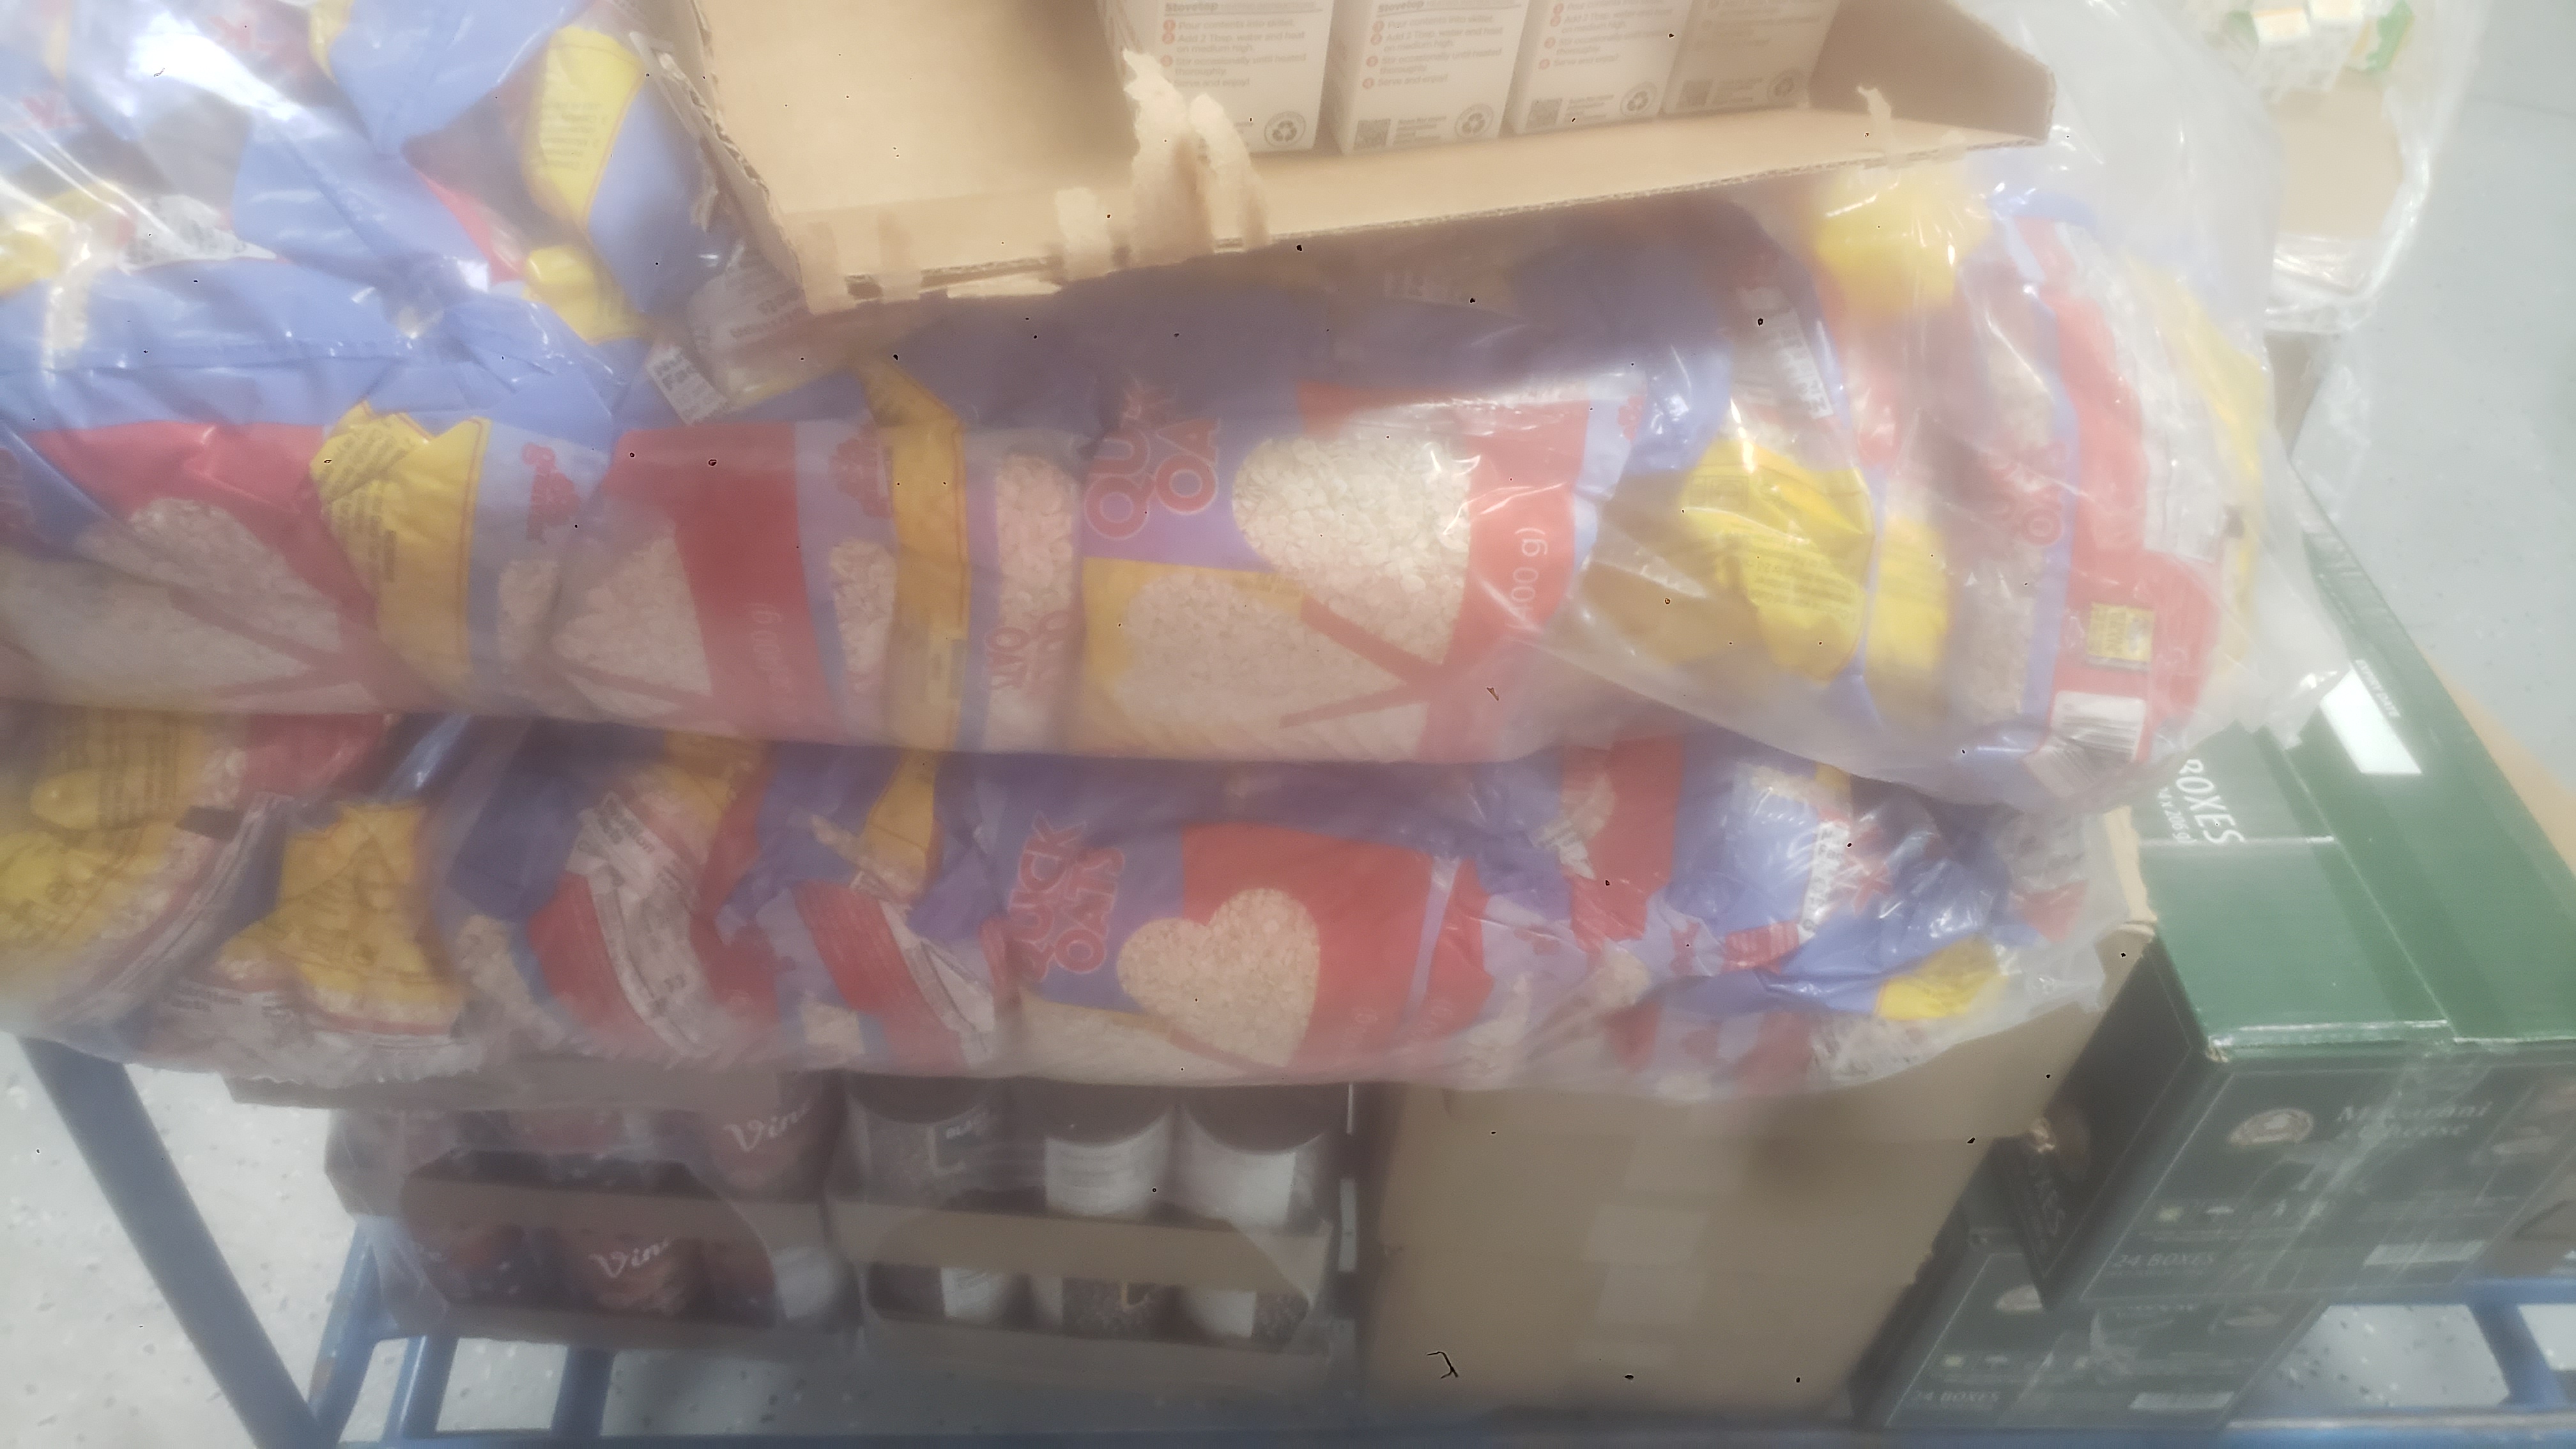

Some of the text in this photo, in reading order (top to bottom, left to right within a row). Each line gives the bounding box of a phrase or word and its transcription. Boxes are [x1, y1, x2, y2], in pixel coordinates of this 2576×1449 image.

[1165, 3, 1218, 13] Stovetop
[1377, 1, 1425, 12] Stovetop
[1204, 20, 1243, 29] contents
[1177, 34, 1198, 42] Add
[1265, 32, 1282, 41] and
[1285, 31, 1305, 39] heat
[1387, 33, 1404, 42] Add
[1397, 42, 1433, 50] medium
[1194, 55, 1250, 66] occasionally
[1253, 55, 1273, 63] until
[1275, 54, 1307, 62] heated
[2164, 809, 2189, 830] 206
[1002, 810, 1087, 982] QUICK
[1051, 845, 1126, 974] OATS
[2336, 1101, 2492, 1123] Maaroni
[723, 1098, 811, 1151] Vin
[588, 1238, 670, 1278] Vin
[2147, 1252, 2216, 1267] BOXES
